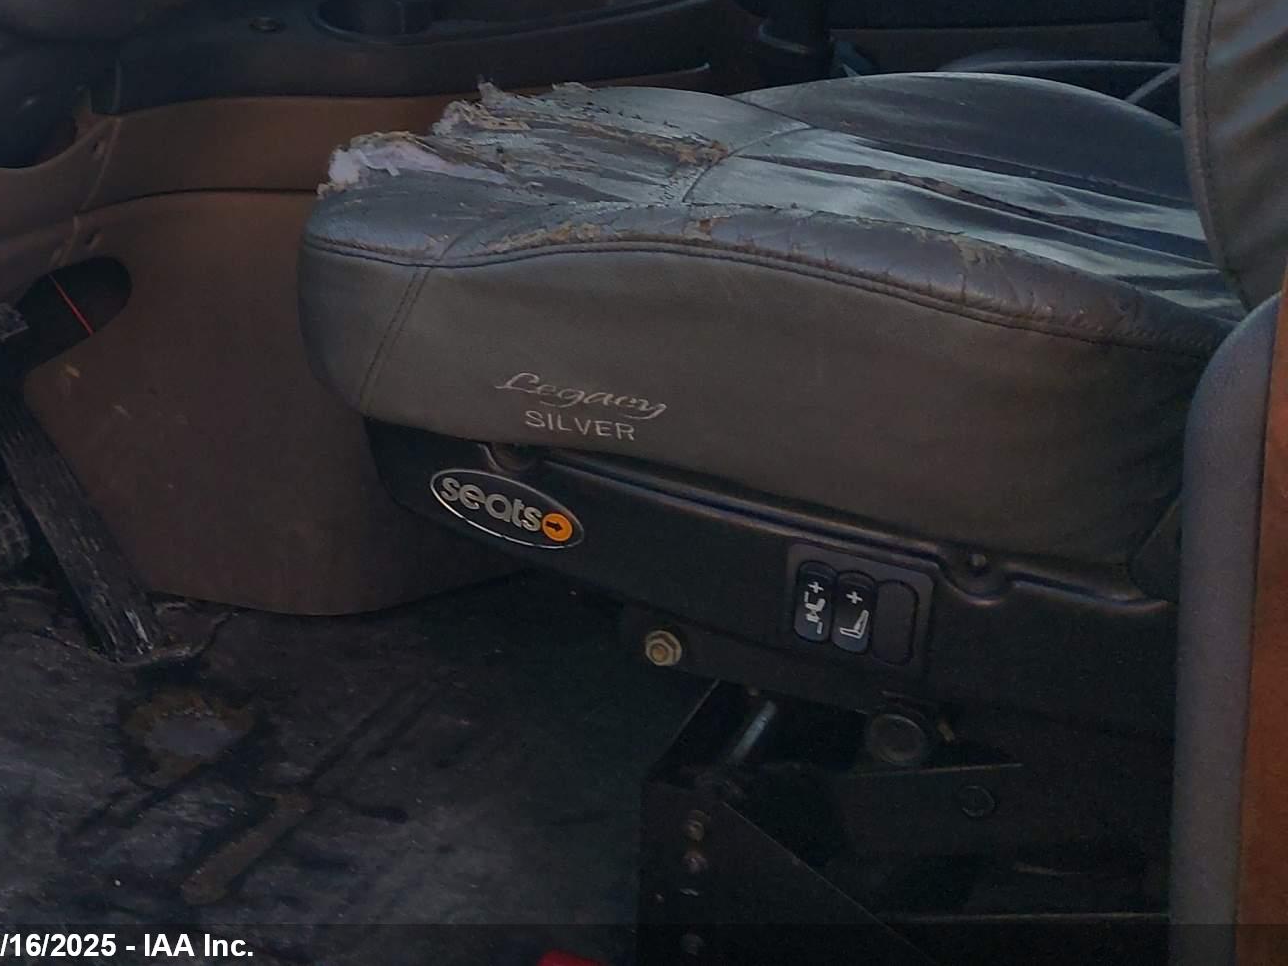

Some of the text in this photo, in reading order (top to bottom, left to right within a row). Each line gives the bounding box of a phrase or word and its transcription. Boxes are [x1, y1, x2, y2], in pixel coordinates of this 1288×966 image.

[495, 372, 667, 420] Legacy
[525, 410, 635, 441] SILVER
[440, 476, 543, 533] seats
